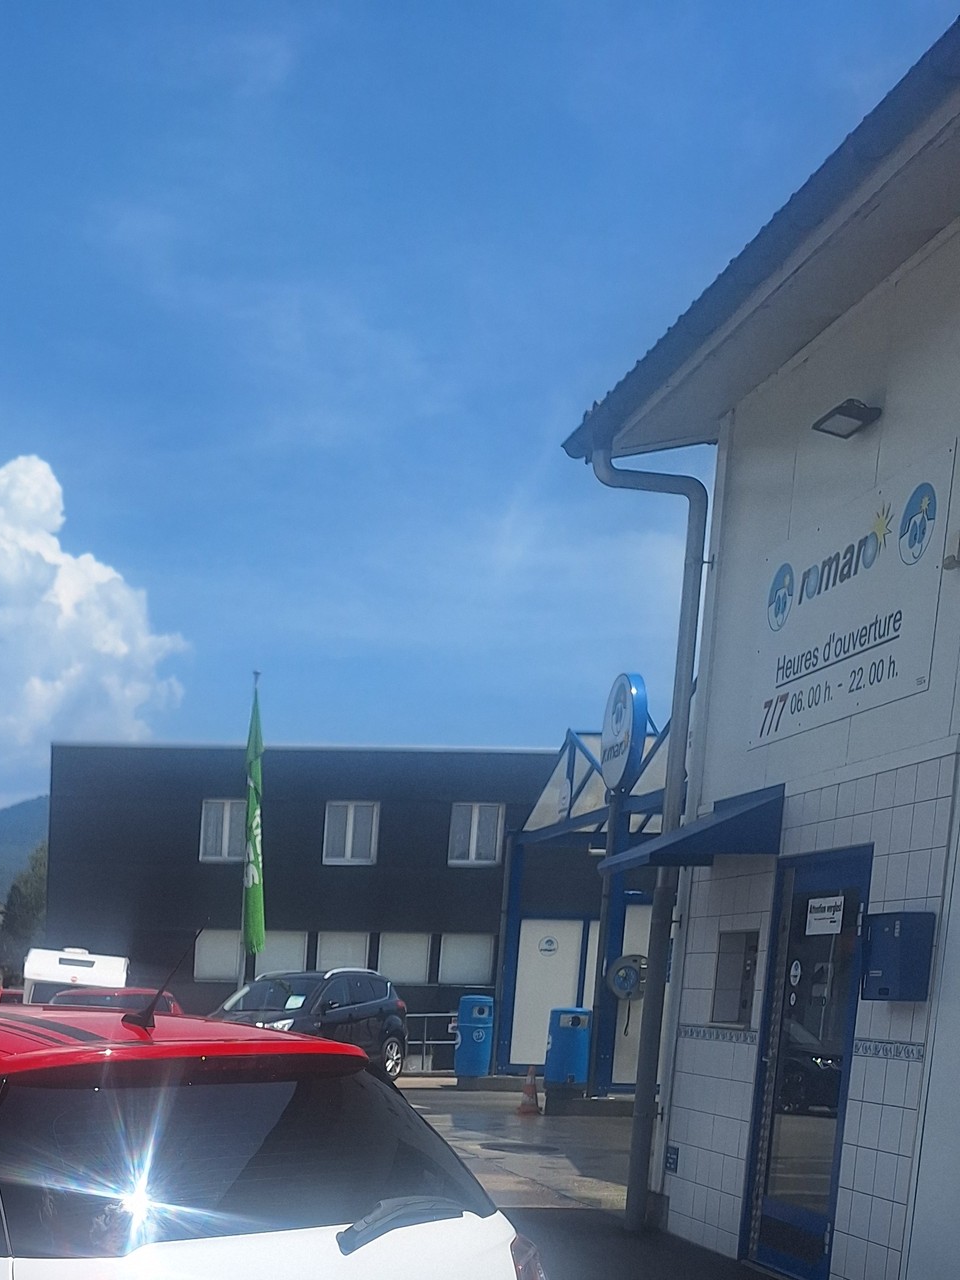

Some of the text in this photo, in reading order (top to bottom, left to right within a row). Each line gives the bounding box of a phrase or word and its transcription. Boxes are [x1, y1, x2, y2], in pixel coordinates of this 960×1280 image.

[798, 531, 879, 606] romaro
[775, 609, 903, 683] Heures d'ouverture
[759, 692, 789, 738] 7/7
